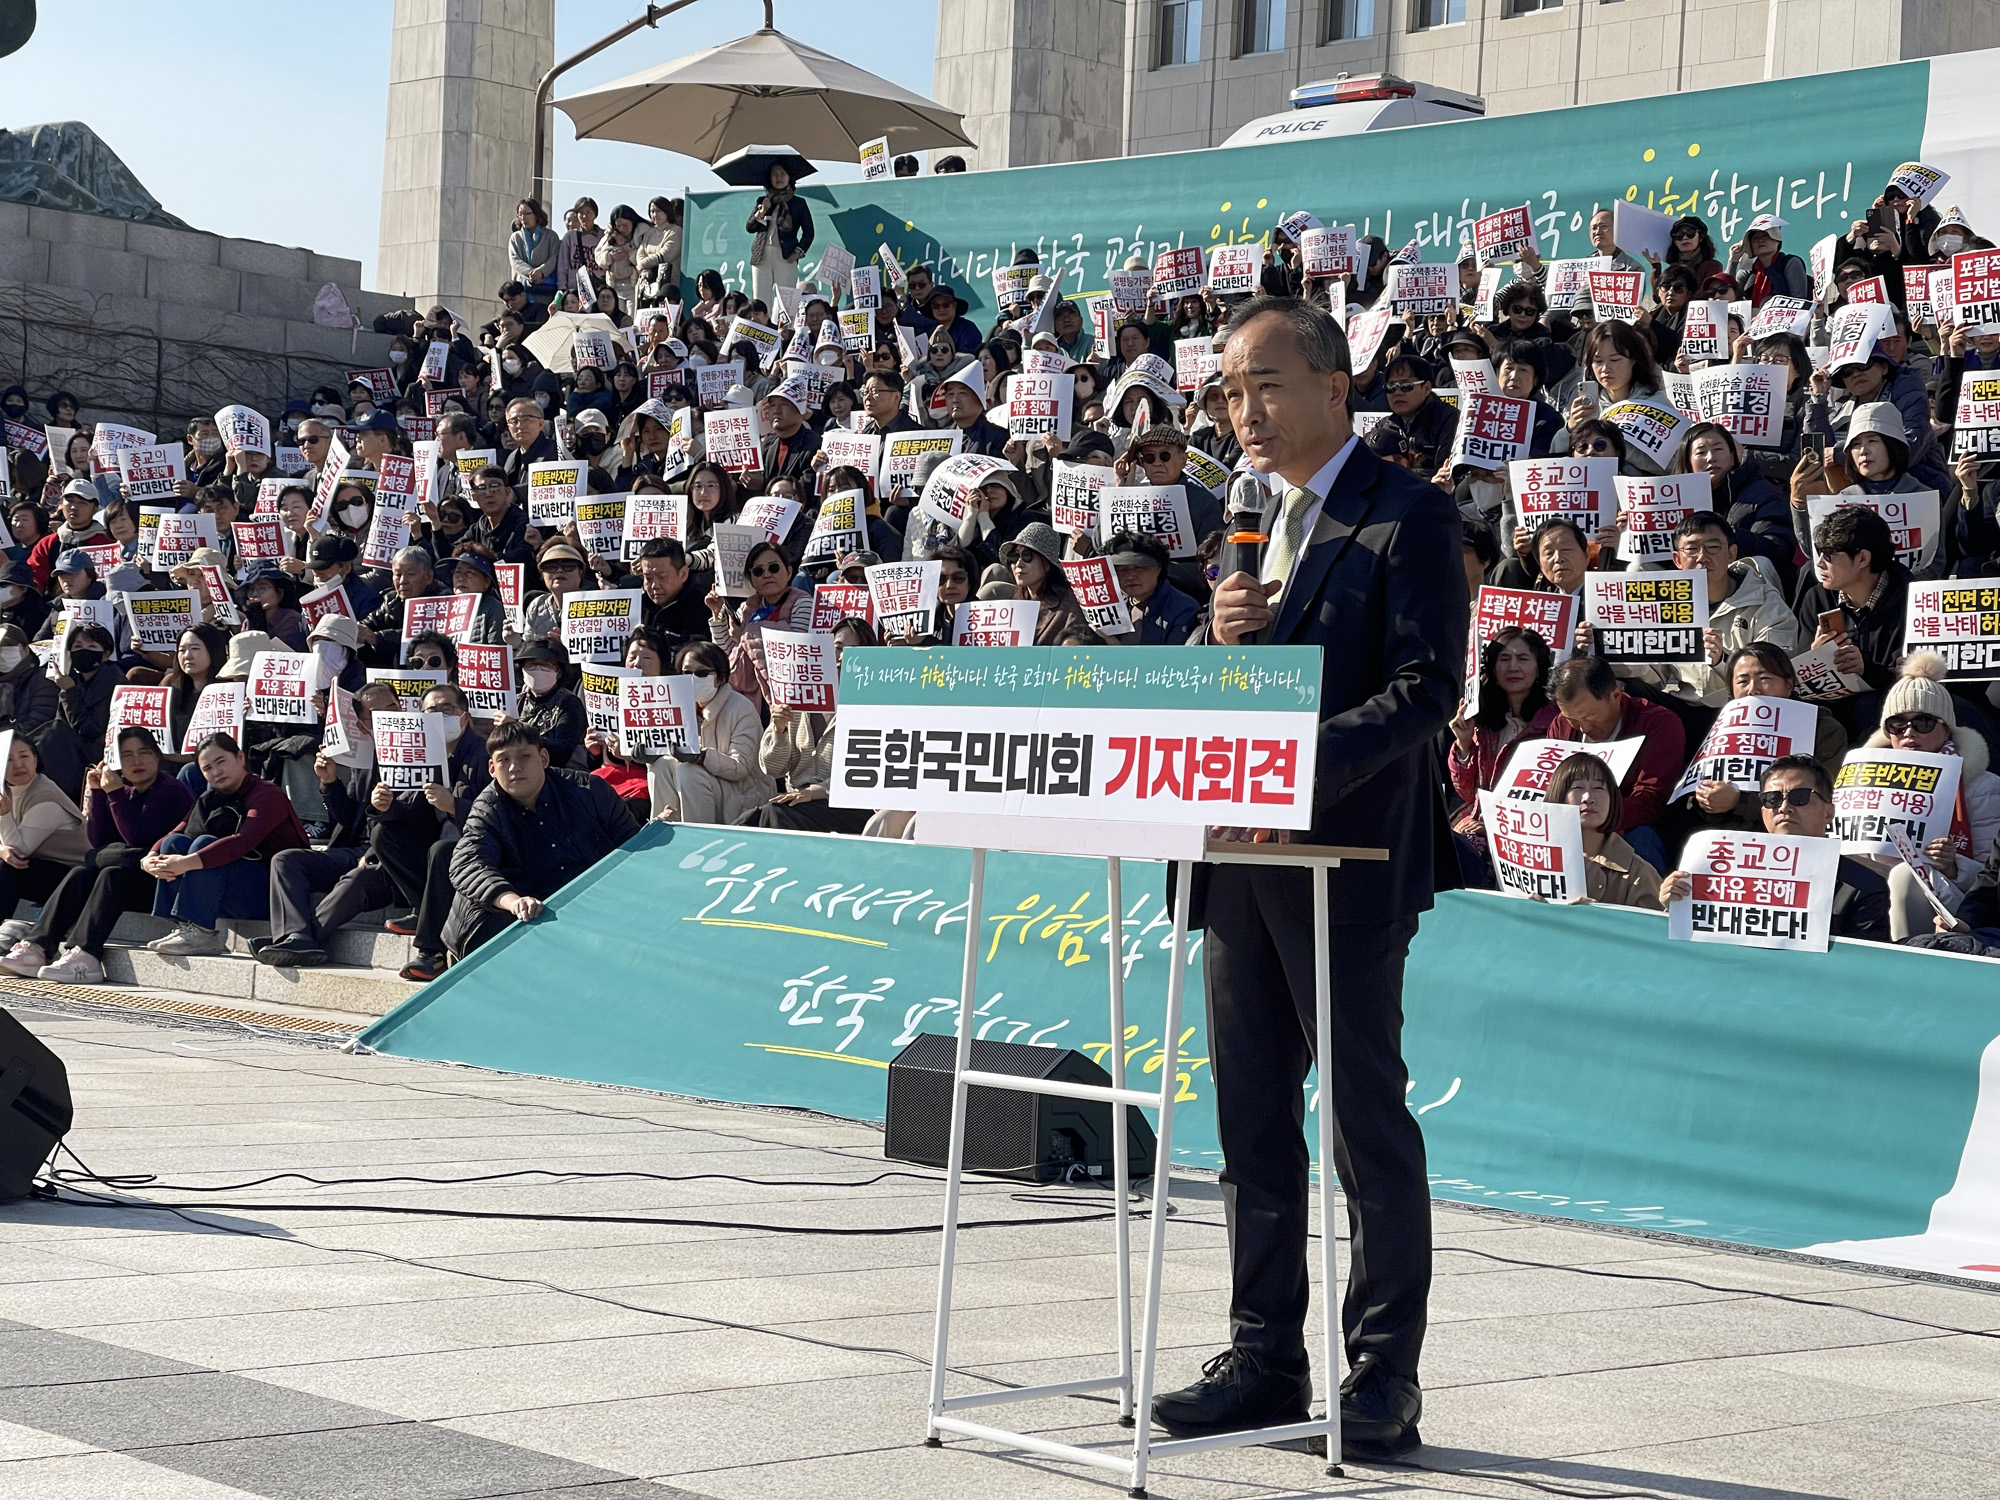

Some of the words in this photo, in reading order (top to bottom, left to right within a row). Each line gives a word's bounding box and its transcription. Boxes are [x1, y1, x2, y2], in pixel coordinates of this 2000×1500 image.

[1256, 120, 1328, 138] POLICE
[1478, 217, 1501, 235] 포괄적
[1503, 211, 1523, 226] 차별
[1478, 231, 1501, 248] 금지법
[1504, 224, 1525, 238] 제정
[1177, 251, 1196, 264] 차별
[1218, 251, 1249, 265] 종교의
[1156, 268, 1176, 281] 금지법
[1178, 263, 1197, 275] 제정
[1216, 265, 1231, 275] 자유
[1233, 263, 1248, 274] 침해
[1398, 267, 1446, 277] 인구주택총조사
[1904, 270, 1926, 283] 포괄적
[1157, 277, 1201, 295] 반대한다!
[1212, 277, 1252, 290] 반대한다!
[1398, 287, 1425, 297] 배우자
[1427, 286, 1446, 296] 등록
[1592, 275, 1614, 290] 포괄적
[1616, 275, 1635, 289] 차별
[1857, 282, 1877, 300] 차별
[1594, 290, 1614, 304] 금지법
[1616, 291, 1633, 304] 제정
[735, 322, 778, 344] 생활동반자법
[1690, 324, 1710, 337] 침해
[1030, 354, 1065, 370] 종교의
[701, 369, 737, 381] 성평등가족부
[1014, 379, 1052, 399] 종교의
[1700, 377, 1742, 396] 성전환수술
[1746, 377, 1770, 391] 없는
[1013, 401, 1027, 415] 자유
[1029, 401, 1050, 415] 침해
[1485, 402, 1521, 421] 차별
[1701, 391, 1769, 418] 성별변경
[707, 417, 750, 434] 성평등가족부
[1482, 420, 1516, 440] 제정
[1645, 419, 1671, 440] 허용)
[708, 434, 751, 450] 성(젠더)평등
[827, 442, 871, 456] 성평등가족부
[892, 440, 953, 456] 생활동반자법
[130, 450, 166, 468] 종교의
[387, 460, 412, 476] 차별
[132, 469, 150, 479] 자유
[152, 468, 169, 478] 침해
[532, 470, 578, 486] 생활동반자법
[1058, 472, 1087, 487] 성전환수술
[1089, 476, 1105, 489] 없는
[1526, 465, 1588, 491] 종교의
[384, 476, 408, 490] 제정
[558, 487, 577, 498] 허용)
[1527, 494, 1551, 510] 자유
[1556, 492, 1588, 509] 침해
[1627, 482, 1681, 511] 종교의
[532, 501, 574, 519] 반대한다!
[635, 500, 678, 511] 인구주택총조사
[834, 498, 854, 515] 허용
[1111, 498, 1151, 513] 성전환수술
[1152, 498, 1173, 512] 없는
[162, 517, 198, 536] 종교의
[633, 512, 649, 524] 동성
[652, 512, 678, 524] 파트너
[834, 514, 855, 529] 허용
[1111, 512, 1176, 534] 성별변경
[1651, 512, 1684, 532] 침해
[237, 528, 255, 541] 포괄적
[257, 525, 276, 540] 차별
[632, 526, 657, 538] 배우자
[660, 526, 678, 538] 등록
[161, 538, 177, 548] 자유
[180, 537, 199, 548] 침해
[239, 543, 257, 556] 금지법
[259, 542, 278, 555] 제정
[1082, 563, 1104, 585] 차별
[890, 582, 920, 596] 파트너
[1087, 584, 1111, 603] 제정
[1596, 582, 1623, 600] 낙태
[1627, 581, 1657, 601] 전면
[1660, 580, 1692, 600] 허용
[132, 599, 190, 613] 생활동반자법
[315, 595, 340, 618] 차별
[819, 590, 845, 607] 포괄적
[848, 589, 870, 608] 차별
[900, 596, 919, 609] 등록
[1482, 595, 1522, 618] 포괄적
[1524, 598, 1563, 619] 차별
[1914, 591, 1940, 613] 낙태
[1943, 589, 1977, 613] 전면
[413, 601, 449, 618] 포괄적
[451, 598, 470, 614] 차별
[568, 600, 631, 618] 생활동반자법
[1597, 604, 1626, 622] 약물
[1629, 604, 1658, 623] 낙태
[1661, 603, 1693, 623] 허용
[134, 614, 169, 626] (동성결합
[173, 613, 193, 626] 허용)
[449, 617, 465, 631] 제정
[568, 619, 603, 635] (동성결합
[607, 618, 631, 632] 허용)
[816, 610, 841, 626] 금지법
[967, 607, 1013, 630] 종교의
[1913, 616, 1941, 637] 약물
[1944, 615, 1978, 636] 낙태
[964, 632, 987, 646] 자유
[990, 631, 1012, 646] 침해
[1603, 630, 1696, 655] 반대한다!
[480, 651, 500, 668] 차별
[766, 641, 823, 662] 성평등가족부
[262, 657, 304, 678] 종교의
[259, 681, 279, 695] 자유
[282, 681, 301, 695] 침해
[480, 671, 502, 688] 제정
[855, 665, 874, 690] 우리
[879, 666, 916, 685] 자녀가
[921, 663, 988, 691] 위험합니다!
[994, 665, 1018, 691] 한국
[1023, 663, 1060, 687] 교회가
[1064, 664, 1138, 693] 위험합니다!
[1145, 665, 1214, 694] 대한민국이
[1219, 664, 1301, 695] 위험합니다!
[121, 691, 145, 706] 포괄적
[147, 691, 164, 707] 차별
[627, 684, 672, 708] 종교의
[254, 698, 306, 717] 반대한다!
[629, 709, 650, 725] 자유
[652, 708, 675, 725] 침해
[144, 710, 162, 725] 제정
[392, 732, 425, 747] 파트너
[626, 727, 687, 748] 반대한다!
[1736, 734, 1779, 756] 침해
[402, 749, 426, 763] 등록
[844, 728, 1094, 797] 통합국민대회
[1105, 735, 1298, 806] 기자회견
[1890, 790, 1934, 817] 허용)
[1495, 803, 1550, 842] 종교의
[1499, 837, 1518, 857] 자유
[1520, 842, 1552, 869] 침해
[1706, 836, 1800, 877] 종교의
[1499, 861, 1567, 900] 반대한다!
[695, 862, 799, 920] 우리
[804, 880, 970, 936] 자녀가
[1706, 876, 1747, 897] 자유
[1753, 878, 1796, 905] 침해
[1691, 904, 1808, 940] 반대한다!
[779, 965, 896, 1053] 한국
